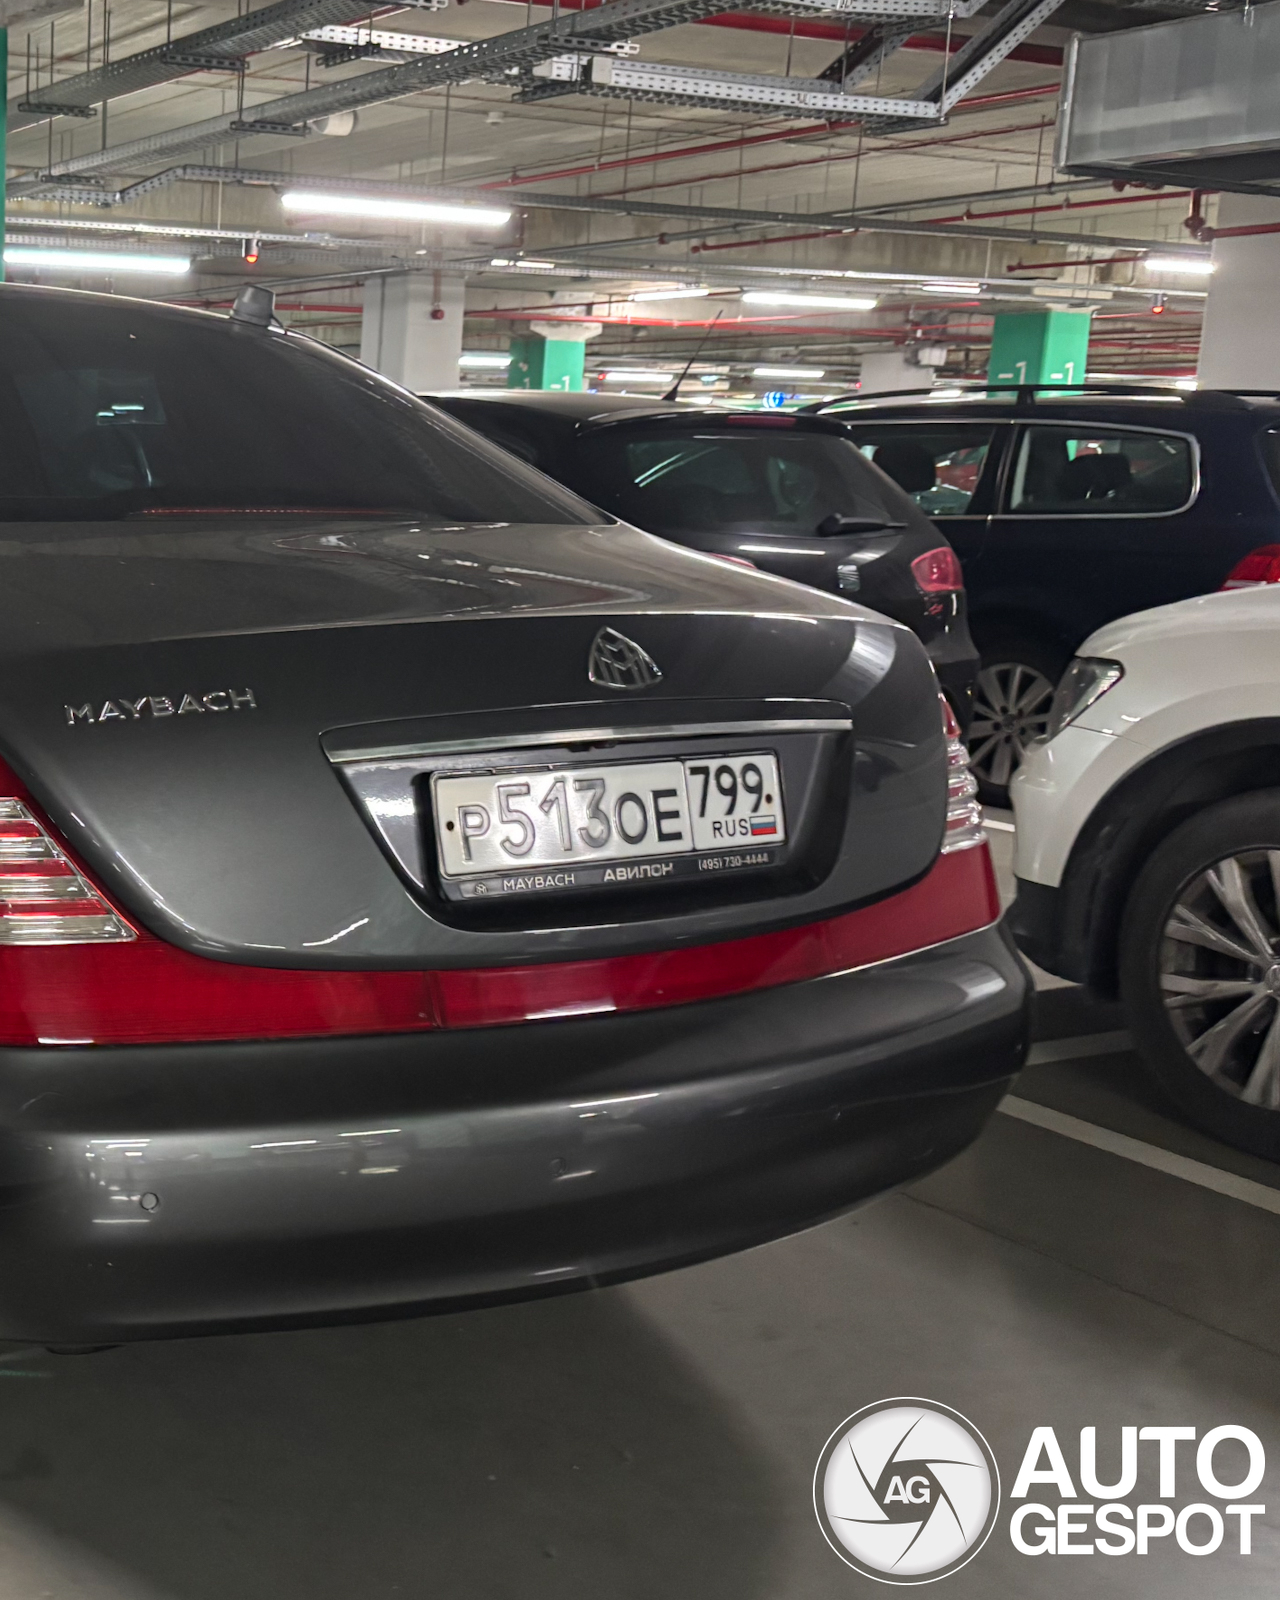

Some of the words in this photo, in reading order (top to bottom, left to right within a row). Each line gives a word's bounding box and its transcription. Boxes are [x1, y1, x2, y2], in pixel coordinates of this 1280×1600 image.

[63, 688, 256, 724] MAYBACH
[688, 762, 763, 818] 799
[712, 818, 749, 838] RUS
[503, 873, 576, 891] MAYBACH
[603, 862, 674, 882] АВИЛОН
